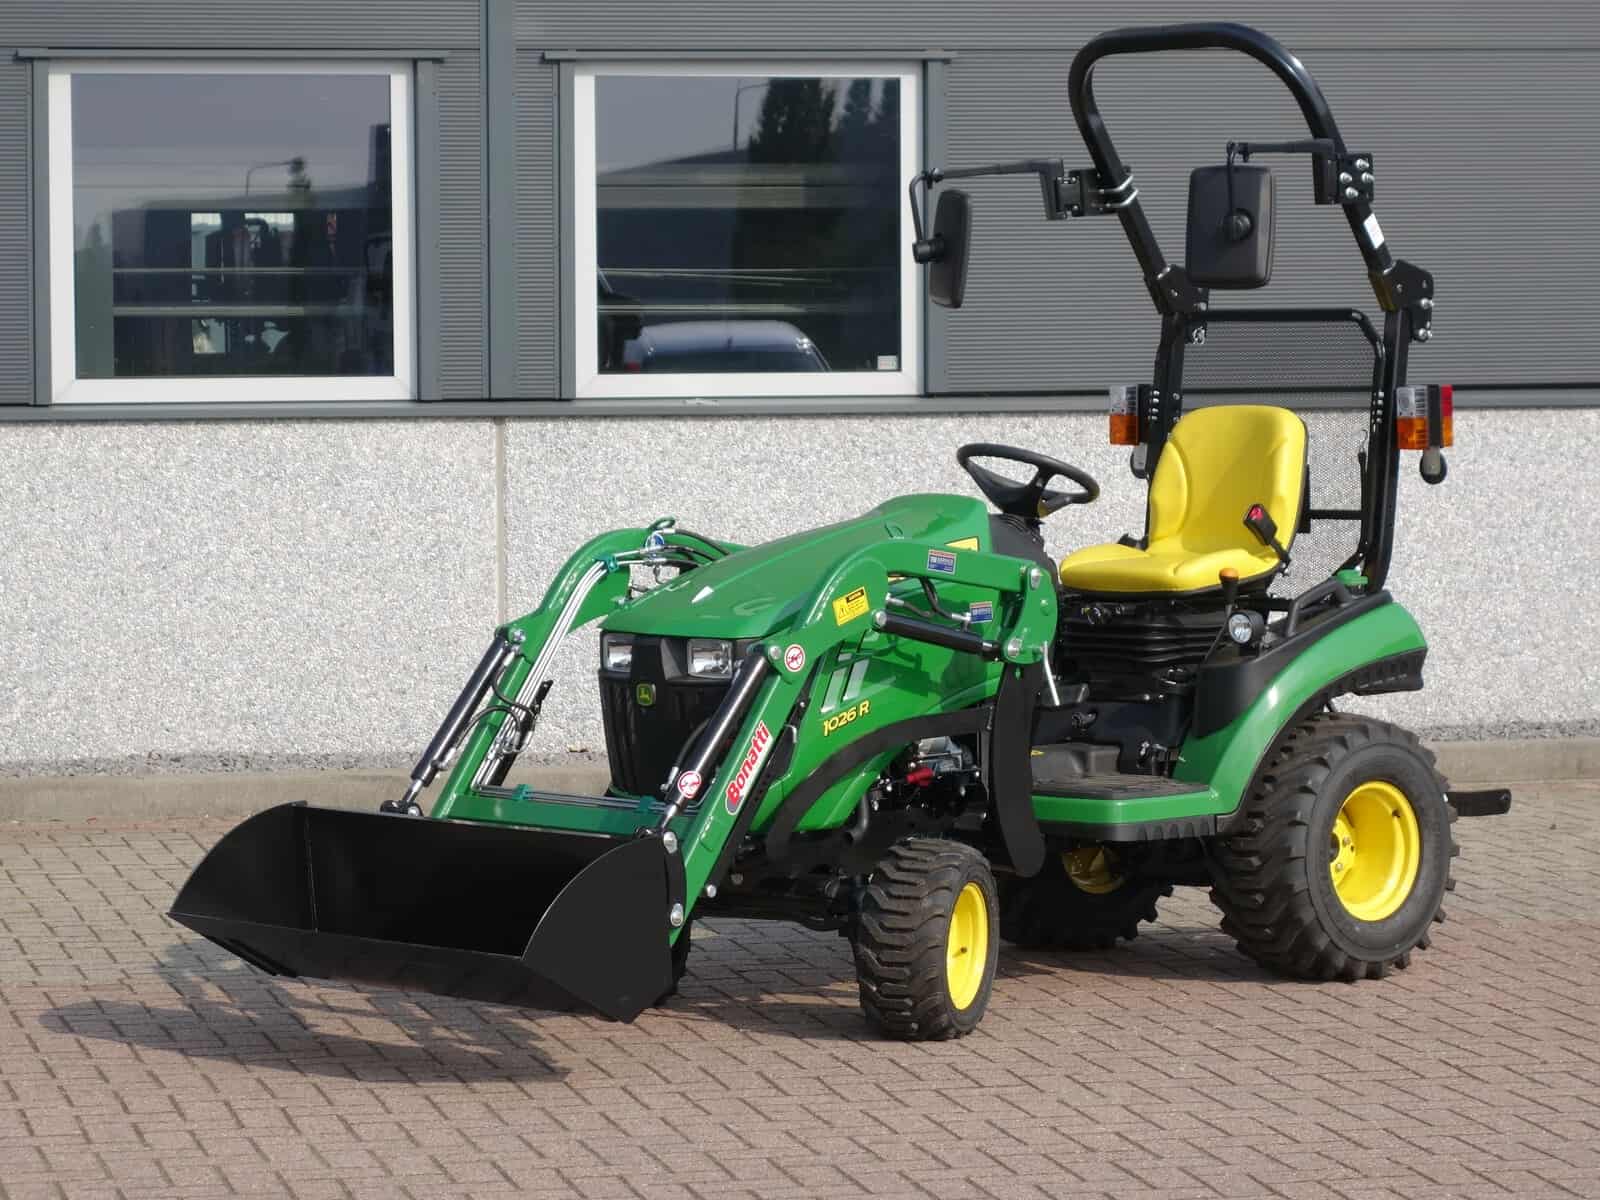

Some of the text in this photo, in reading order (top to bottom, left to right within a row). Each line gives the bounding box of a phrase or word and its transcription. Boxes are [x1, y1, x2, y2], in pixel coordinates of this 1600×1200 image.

[823, 699, 870, 737] 1026 R
[727, 721, 770, 806] Bonatti
